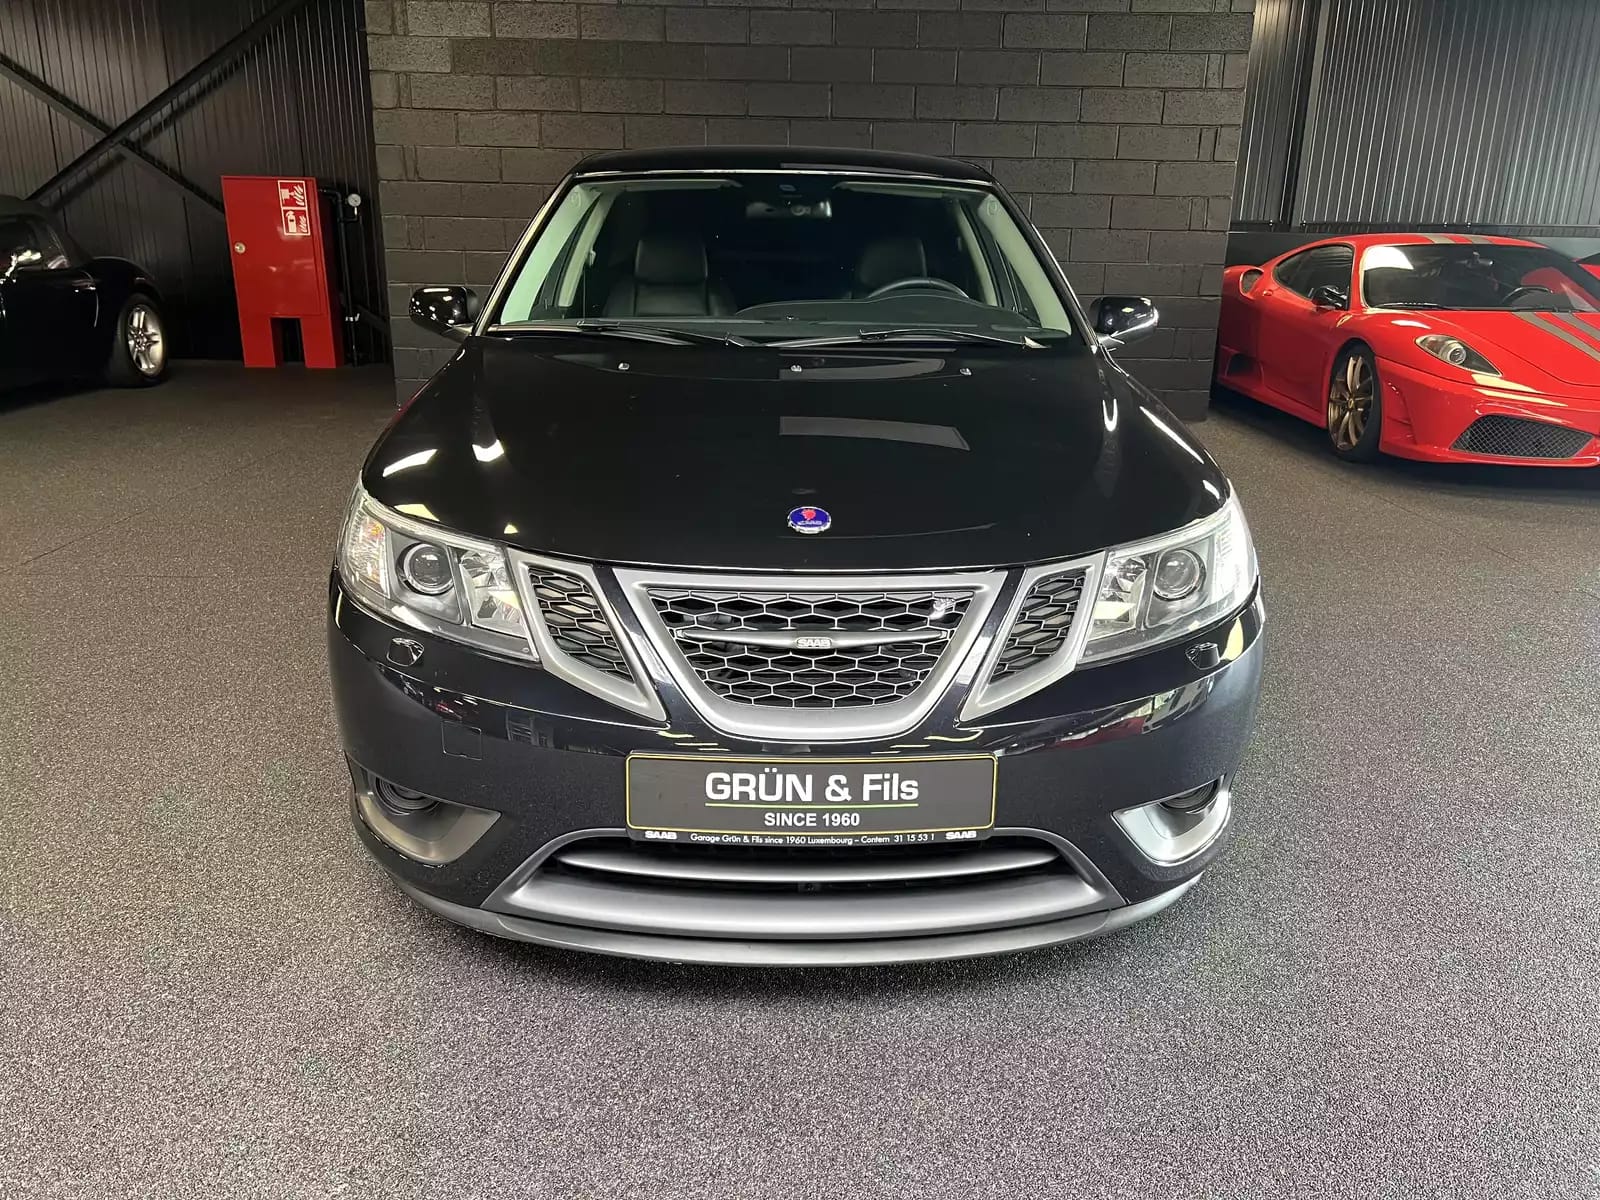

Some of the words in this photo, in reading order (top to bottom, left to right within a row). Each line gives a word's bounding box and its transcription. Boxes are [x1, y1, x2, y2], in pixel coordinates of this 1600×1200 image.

[797, 638, 831, 648] SAAB
[705, 767, 813, 802] GRÜN
[824, 774, 852, 802] &
[862, 773, 919, 802] Fils
[764, 812, 817, 827] SINCE
[822, 812, 860, 827] 1960
[645, 830, 677, 840] SAAB
[690, 833, 720, 843] Garage
[721, 834, 741, 843] Grün
[752, 835, 762, 844] Fils
[764, 836, 783, 844] since
[786, 836, 806, 844] 1960
[807, 836, 853, 845] Luxembourg
[894, 835, 903, 843] 31
[906, 835, 916, 843] 15
[917, 834, 929, 842] 53
[945, 831, 977, 840] SAAB
